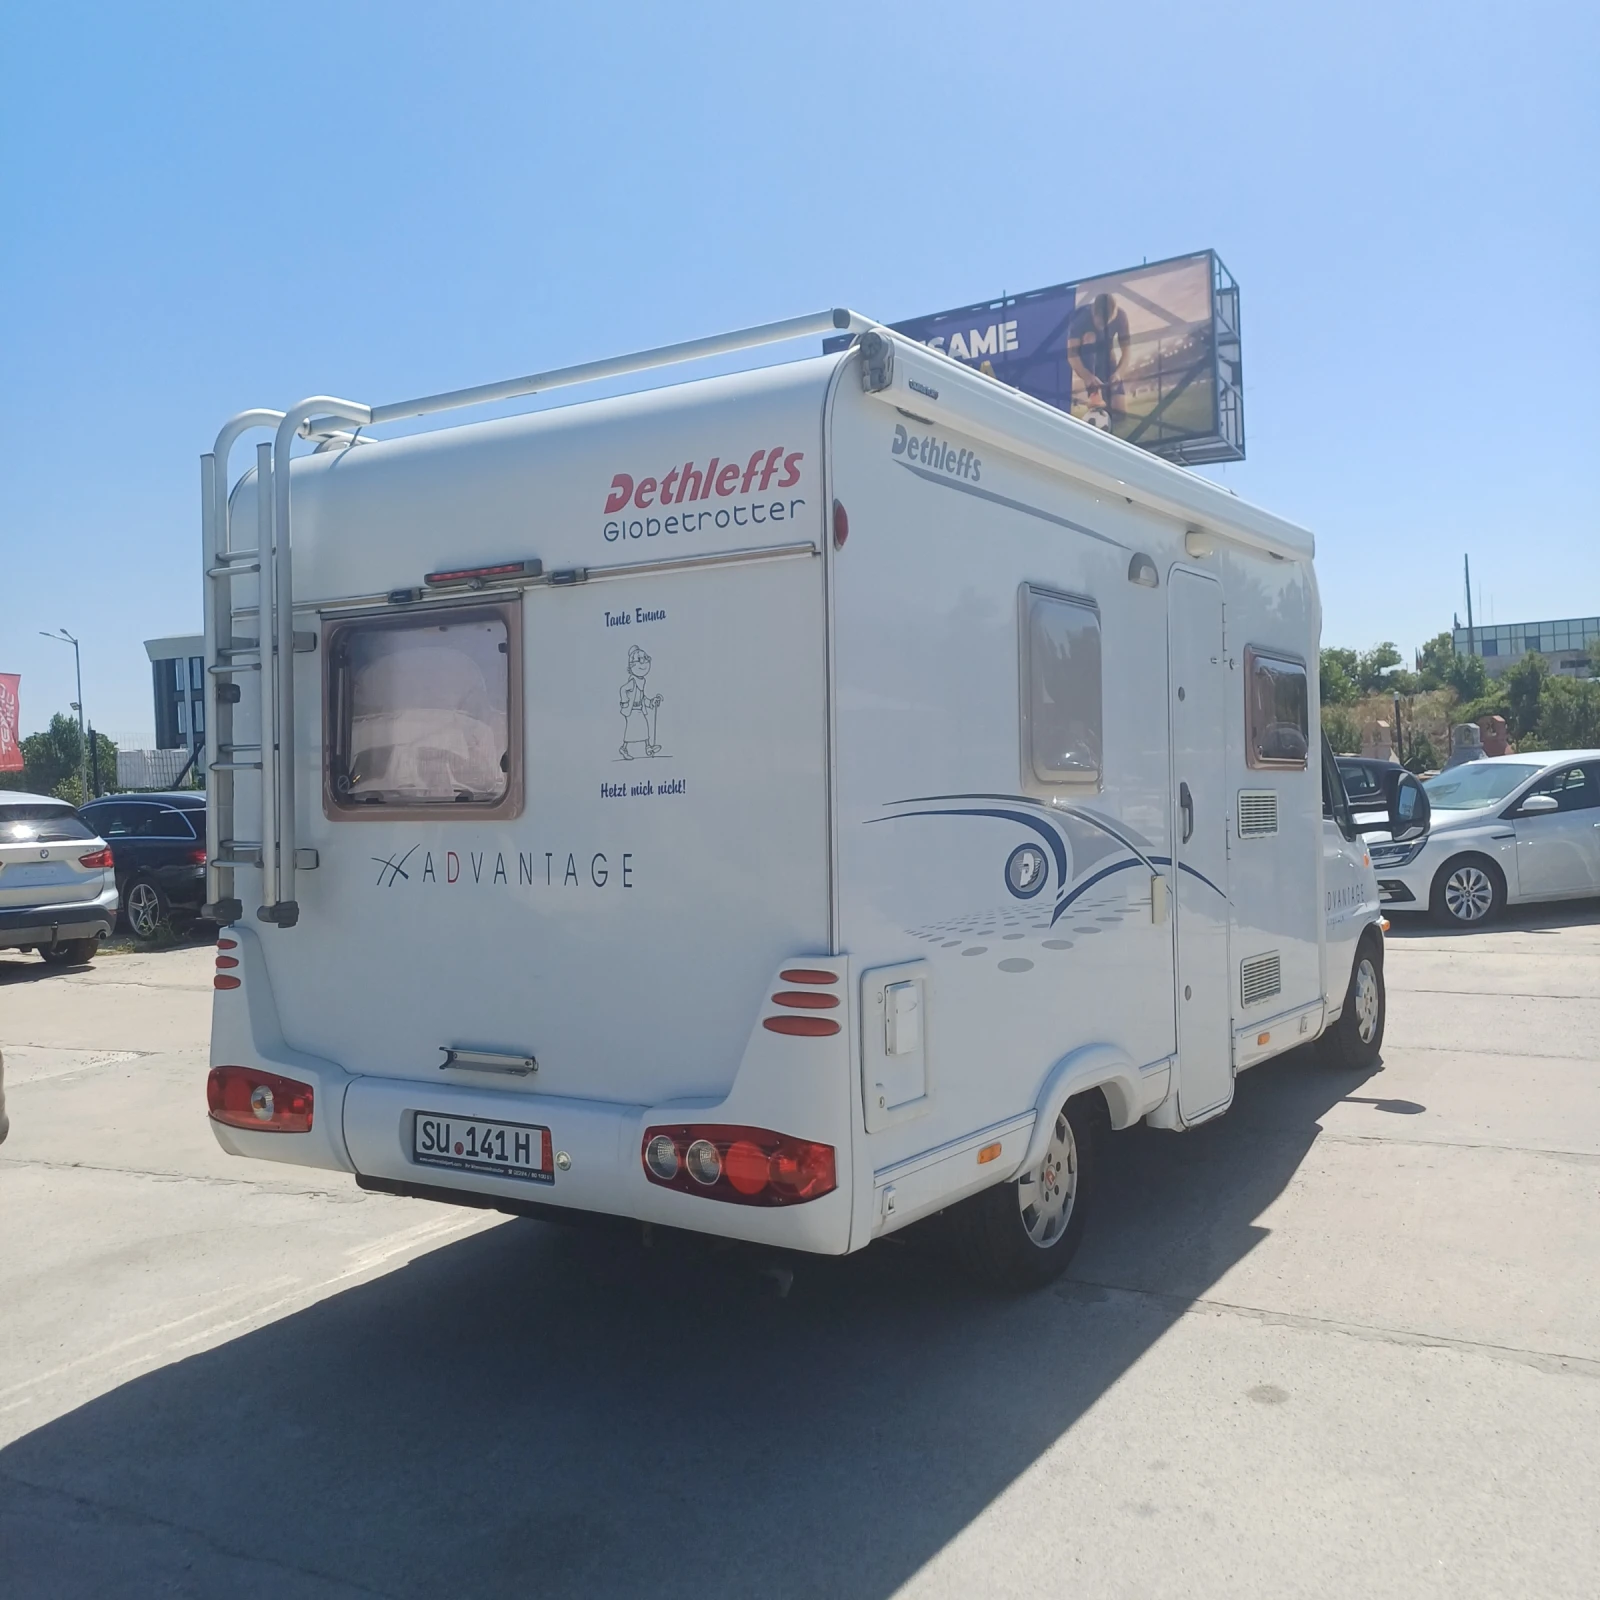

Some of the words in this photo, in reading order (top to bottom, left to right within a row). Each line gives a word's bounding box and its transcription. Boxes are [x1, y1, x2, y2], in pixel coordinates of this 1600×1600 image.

[920, 320, 1019, 360] SAME
[892, 423, 982, 482] Dethleffs
[603, 446, 805, 514] Dethleffs
[603, 499, 806, 542] Globetrotter
[604, 611, 631, 627] Tante
[635, 607, 667, 623] Emma
[601, 782, 627, 798] Hetzt
[631, 780, 654, 796] mich
[658, 778, 686, 795] nicht!
[422, 851, 633, 888] ADVANTAGE
[1324, 883, 1366, 912] DVANTAGE
[421, 1120, 451, 1154] SU
[465, 1126, 509, 1162] 141
